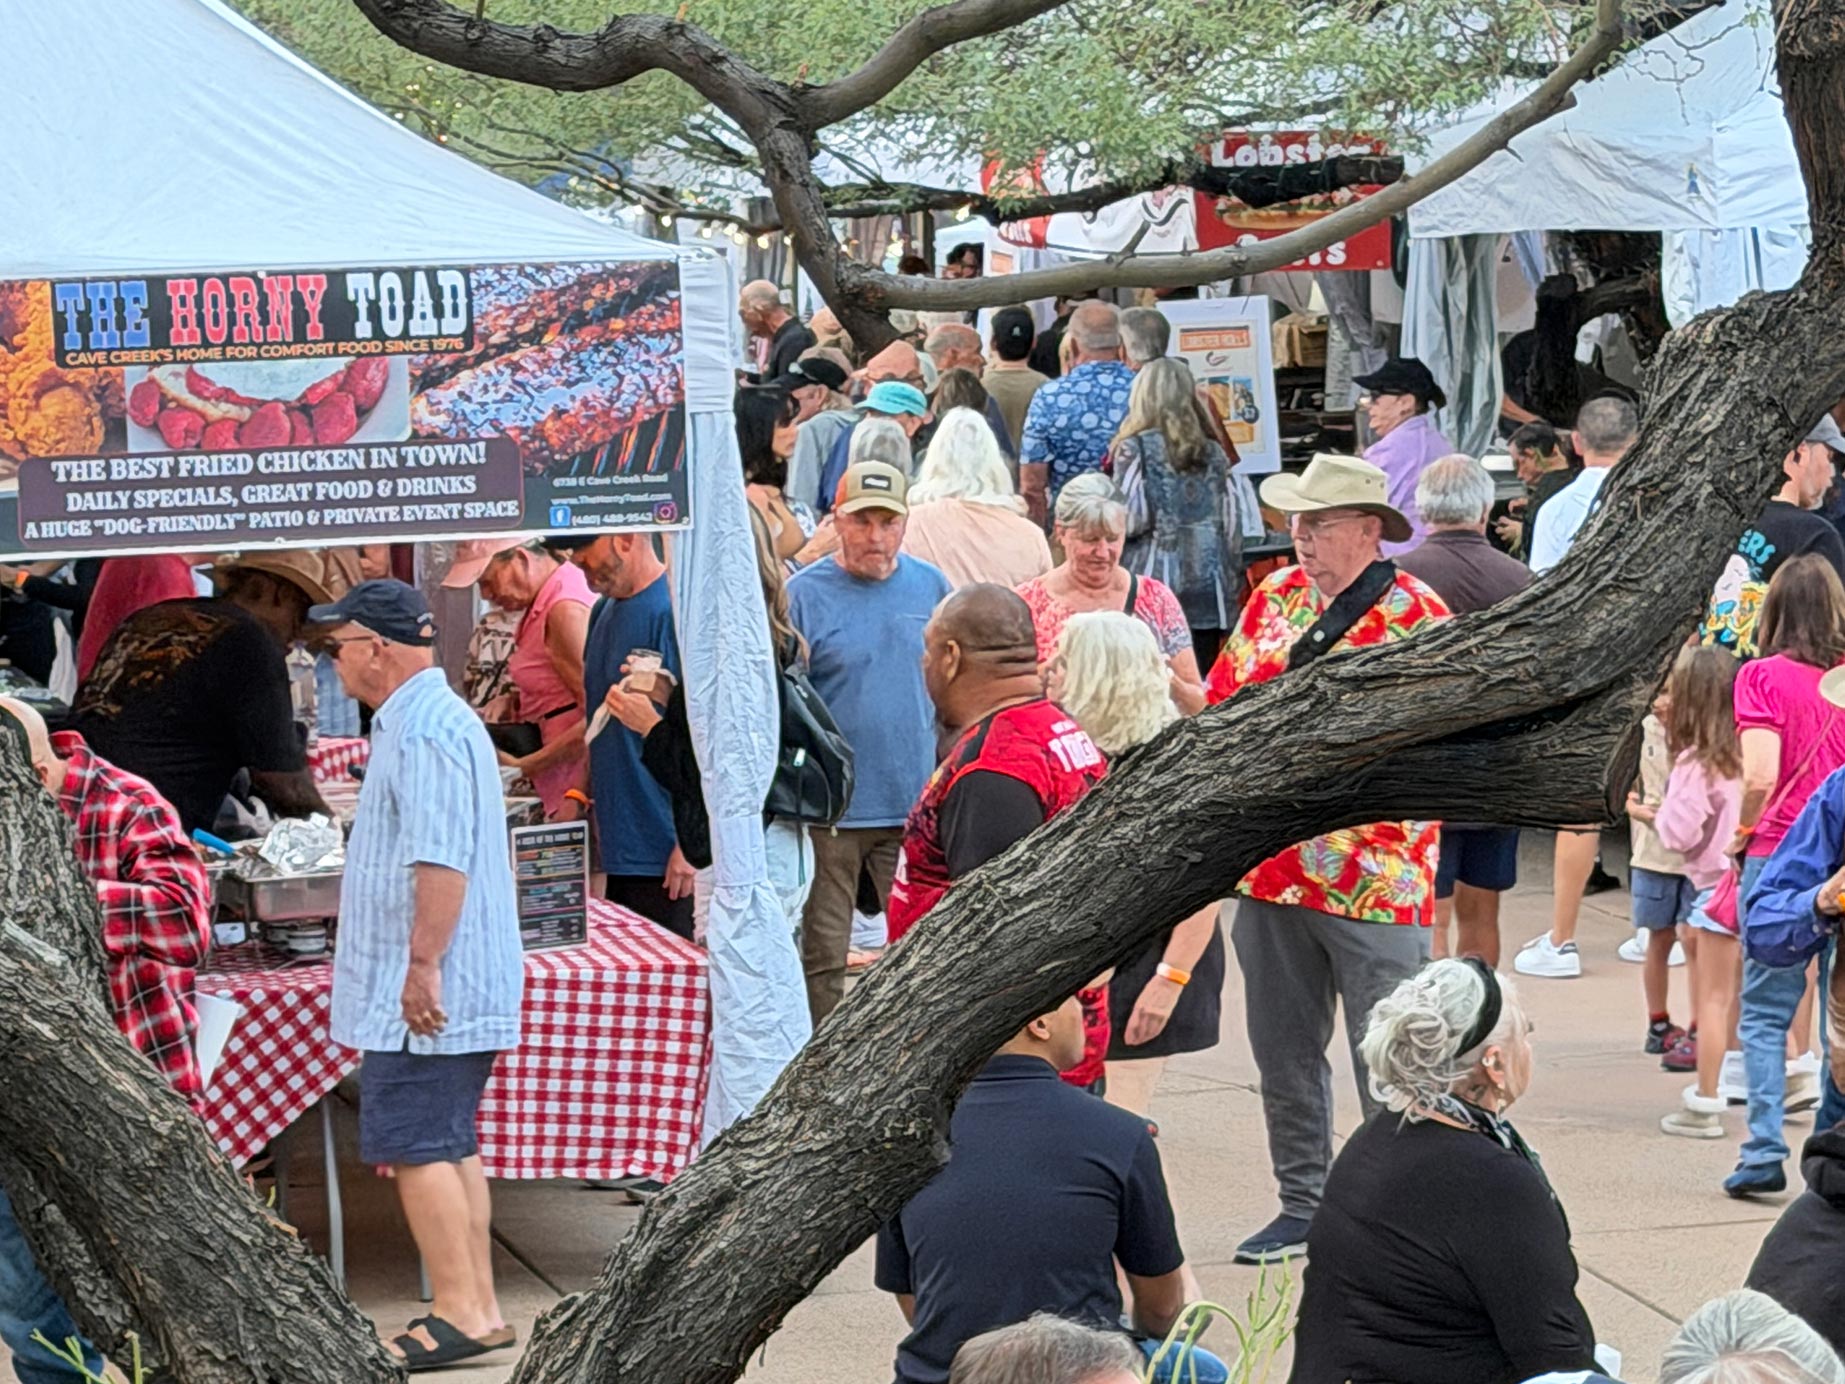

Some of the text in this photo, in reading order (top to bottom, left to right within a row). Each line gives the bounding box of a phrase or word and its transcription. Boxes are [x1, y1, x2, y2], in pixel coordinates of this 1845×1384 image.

[55, 270, 468, 350] THE HORNY TOAD
[65, 337, 465, 366] CAVE CREEK'S HOME FOR COMFORT FOOD SINCE 1976
[51, 441, 487, 483] THE BEST FRIED CHICKEN IN TOWN!
[586, 475, 611, 486] Cave
[612, 474, 641, 485] Creek
[65, 474, 477, 513] DAILY SPECIALS, GREAT FOOD & DRINKS
[24, 500, 520, 539] A HUGE "DOG-FRIENDLY" PATIO & PRIVATE EVENT SPACE
